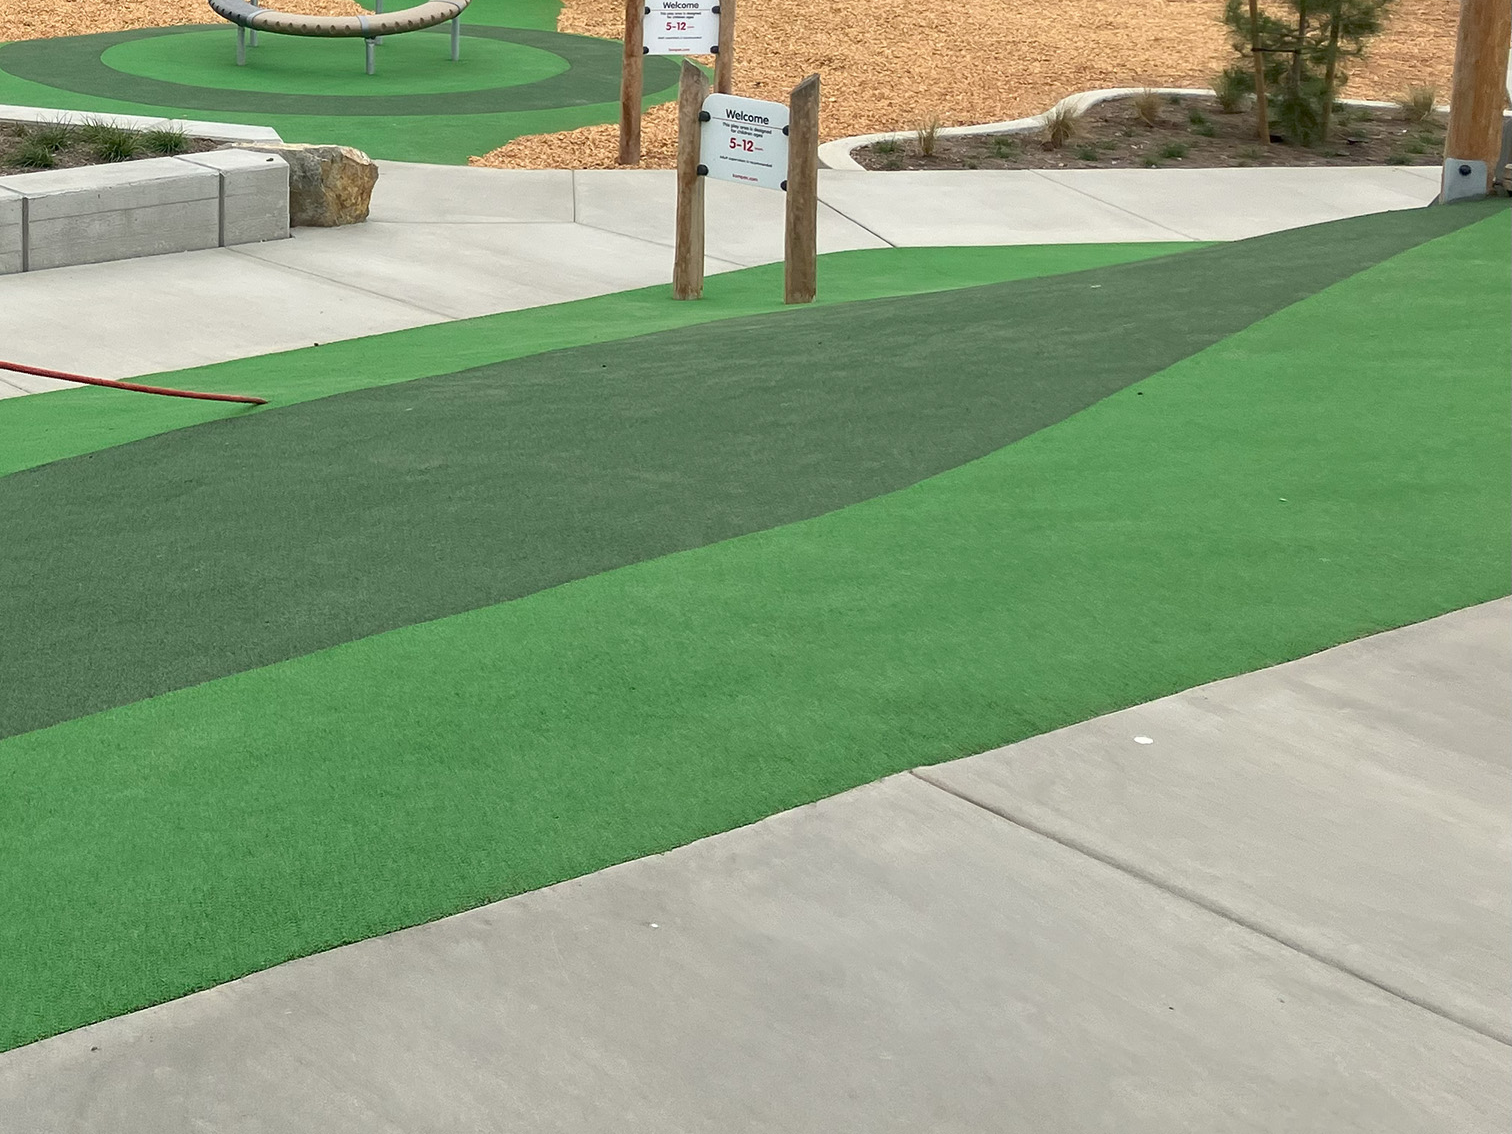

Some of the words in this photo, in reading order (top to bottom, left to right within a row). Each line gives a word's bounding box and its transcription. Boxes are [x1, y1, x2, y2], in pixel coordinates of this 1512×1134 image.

[662, 1, 699, 9] Welcome
[665, 21, 687, 31] 5-12
[725, 108, 769, 125] Welcome
[729, 137, 754, 152] 5-12
